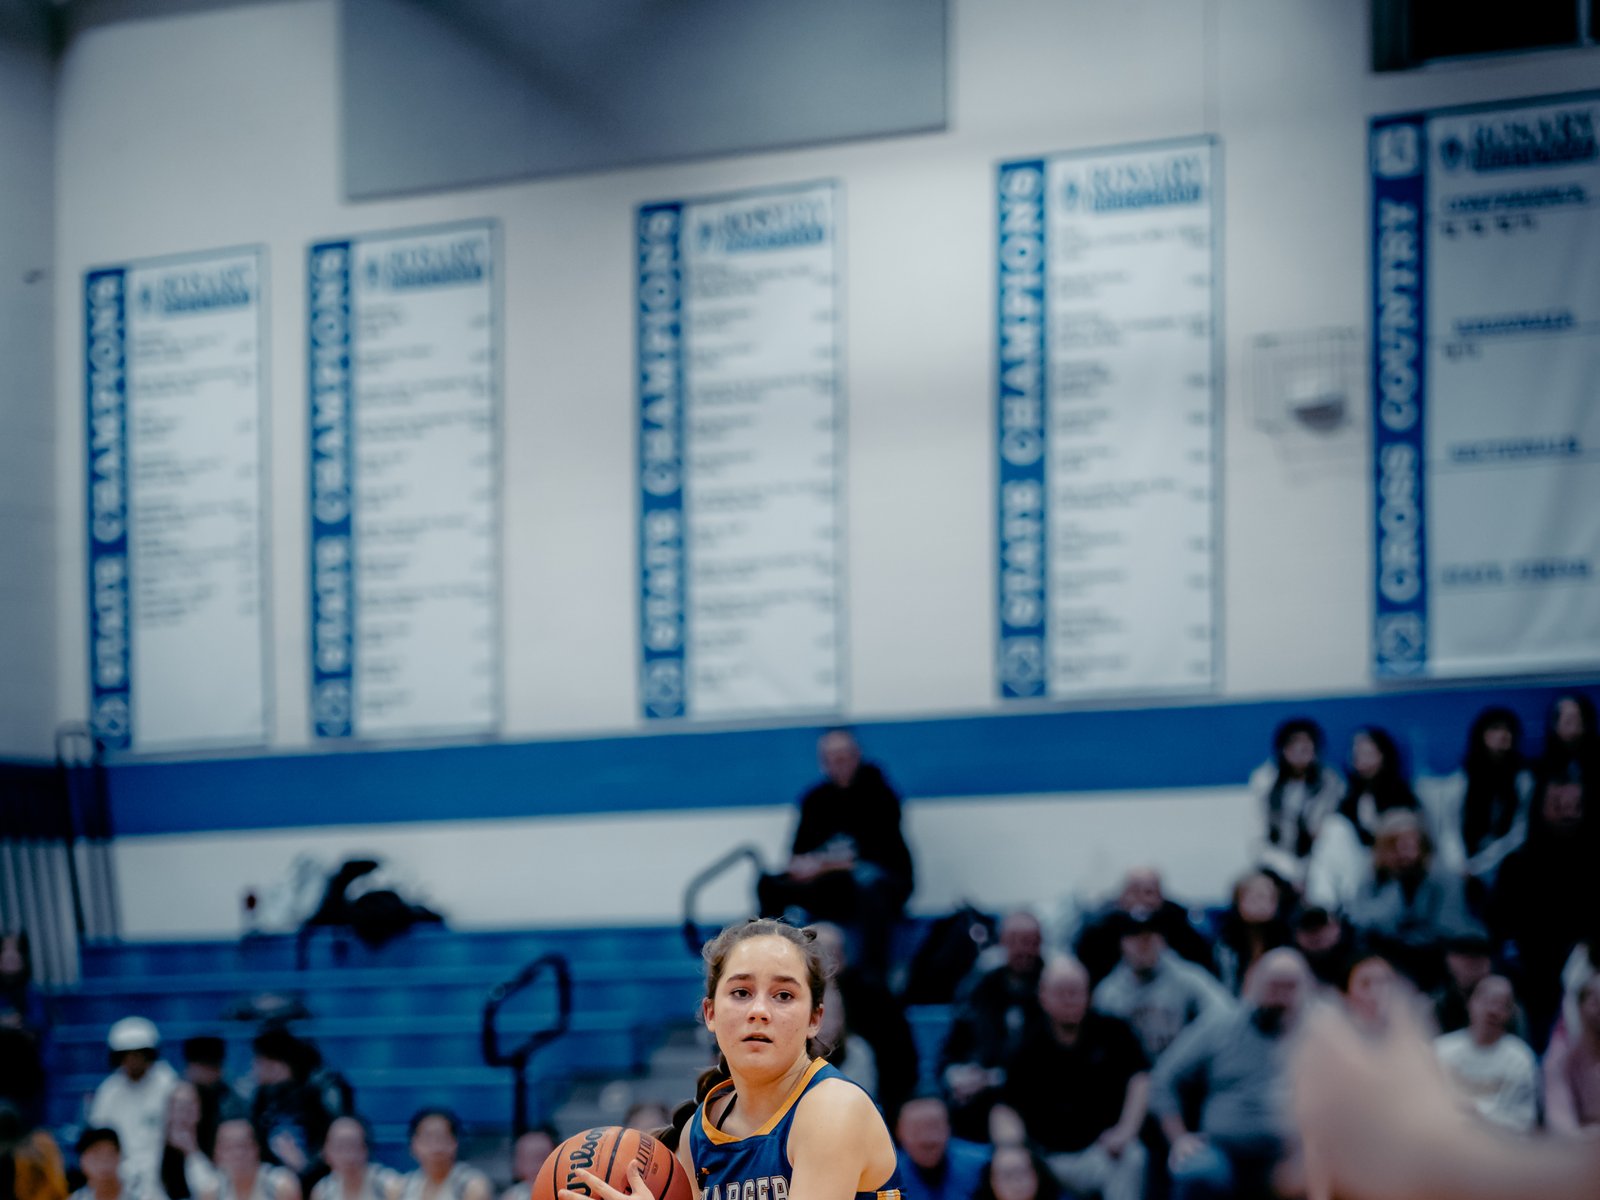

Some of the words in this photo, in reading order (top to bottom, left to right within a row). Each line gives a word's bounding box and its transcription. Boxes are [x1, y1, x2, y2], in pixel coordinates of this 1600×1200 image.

[313, 248, 348, 524] CHAMPIONS
[641, 210, 681, 496] CHAMPIONS
[1001, 167, 1043, 466] CHAMPIONS
[1379, 199, 1420, 432] COUNTRY
[1379, 442, 1420, 602] CROSS
